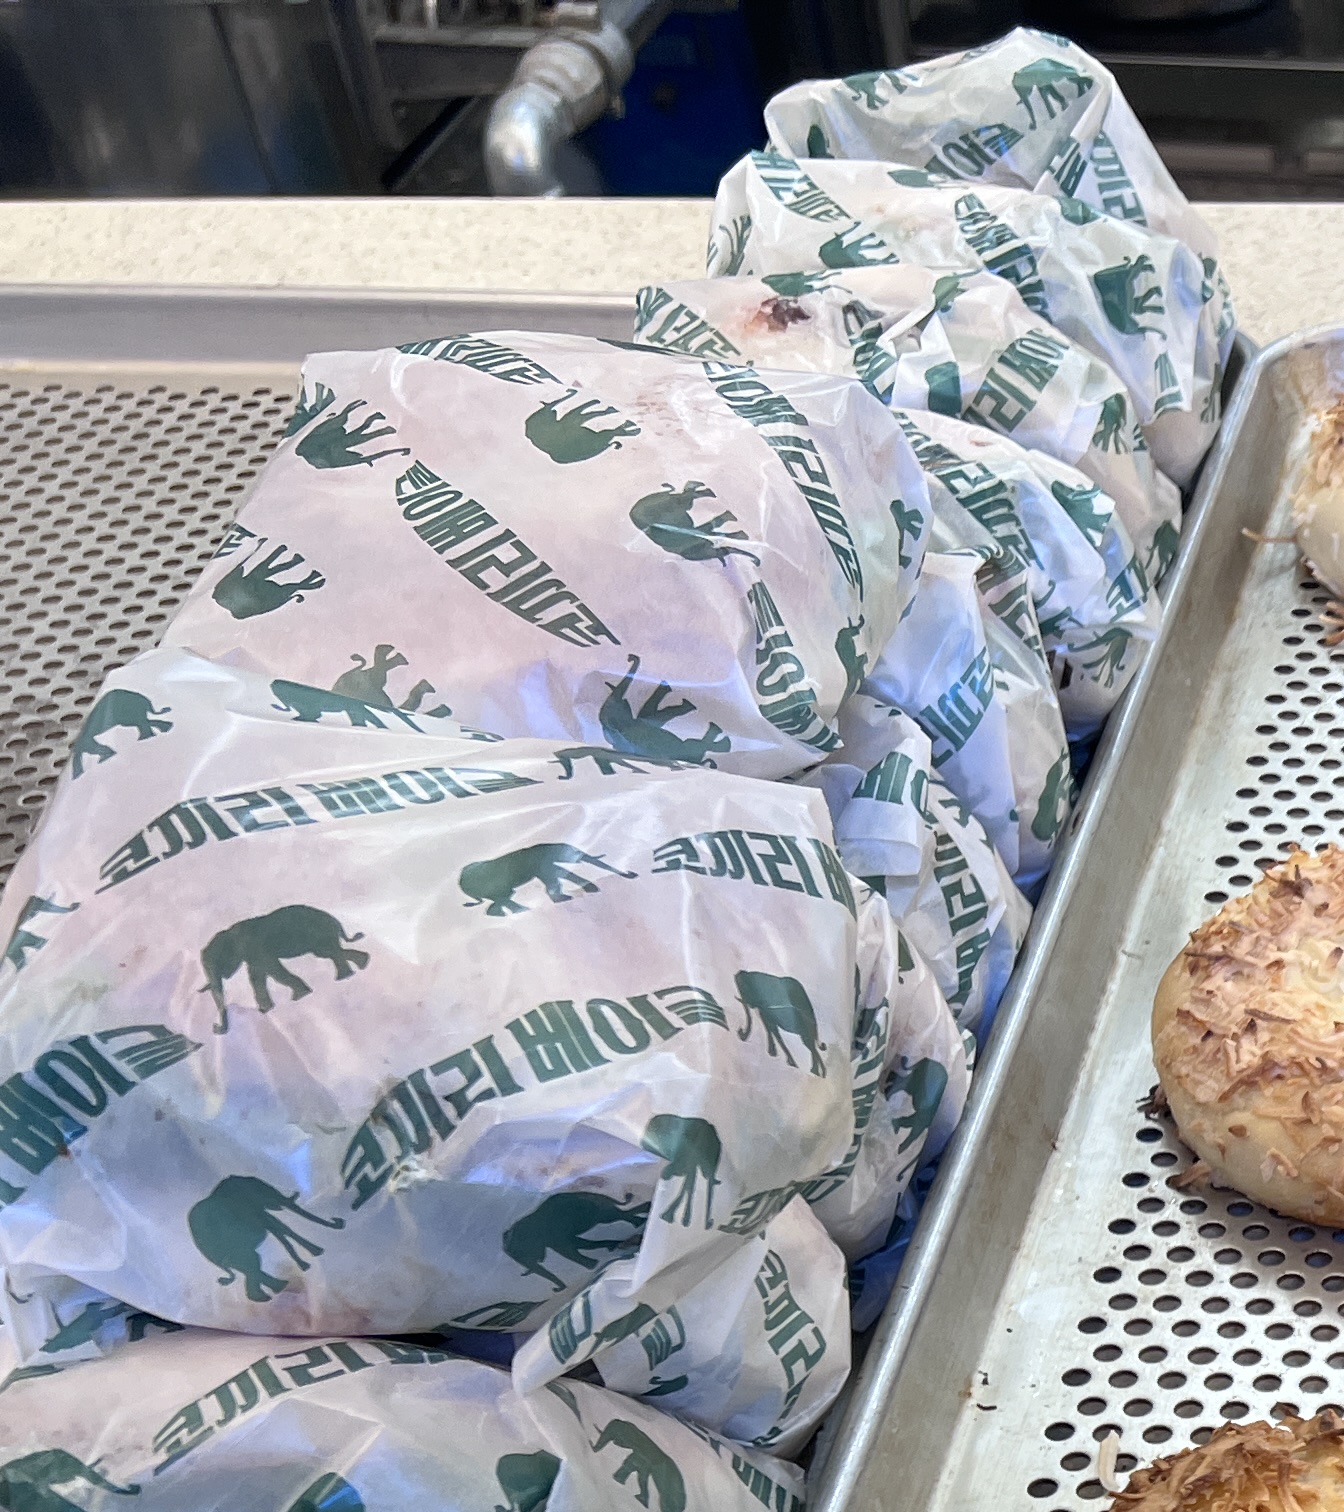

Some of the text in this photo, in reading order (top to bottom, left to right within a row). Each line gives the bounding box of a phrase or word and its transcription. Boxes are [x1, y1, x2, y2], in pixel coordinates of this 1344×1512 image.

[445, 527, 622, 648] 코끼리
[95, 766, 544, 895] 코끼리 베이글
[651, 829, 824, 899] 코끼리
[340, 1034, 526, 1212] 코끼리
[504, 985, 730, 1084] 베이글
[152, 1341, 375, 1476] 코끼리
